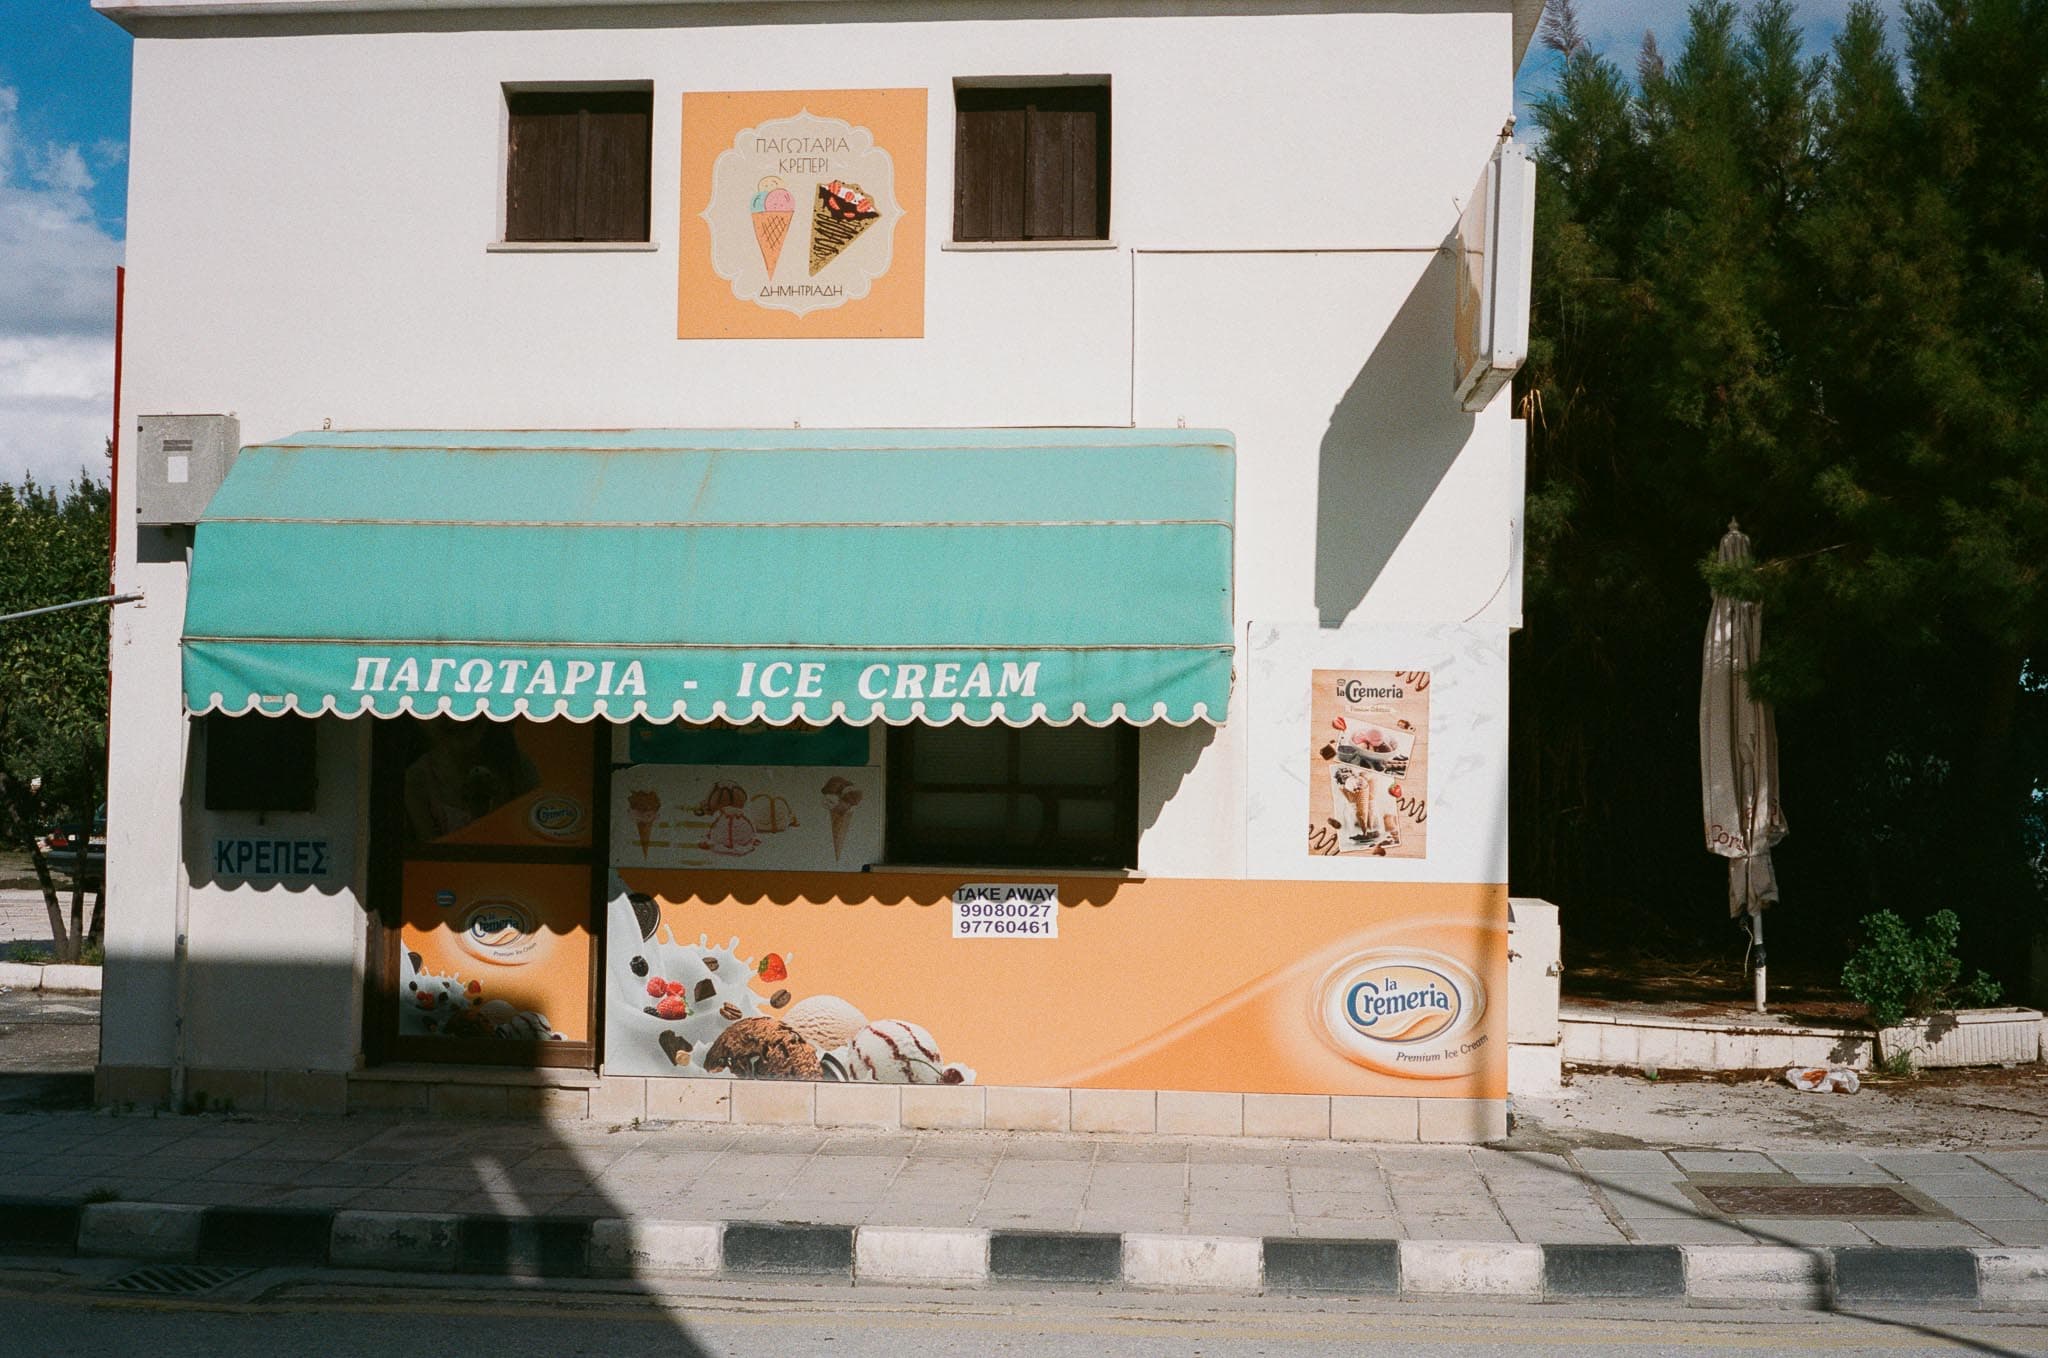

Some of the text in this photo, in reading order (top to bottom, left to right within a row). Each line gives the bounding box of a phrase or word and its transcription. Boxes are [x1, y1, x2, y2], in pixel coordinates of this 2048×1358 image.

[756, 137, 850, 153] ΠΑΓΩΤΑΡΙΑ
[778, 157, 829, 173] ΚΡΕΠΕΡΙ
[759, 285, 843, 297] ΔΗΜΗΤΡΙΑΔΗ
[351, 657, 647, 696] ΠΑΓΩΤΑΡΙΑ
[737, 661, 826, 699] ICE
[858, 661, 1042, 699] CREAM
[1345, 679, 1404, 703] Cremeria
[217, 841, 327, 874] ΚΡΕΠΕΣ
[956, 888, 1057, 900] TAKE AWAY
[960, 904, 1051, 917] 99080027
[960, 921, 1049, 934] 97760461
[1385, 977, 1398, 992] la
[1346, 982, 1450, 1026] Cremeria
[1395, 1034, 1489, 1063] Premium Ice Cream
